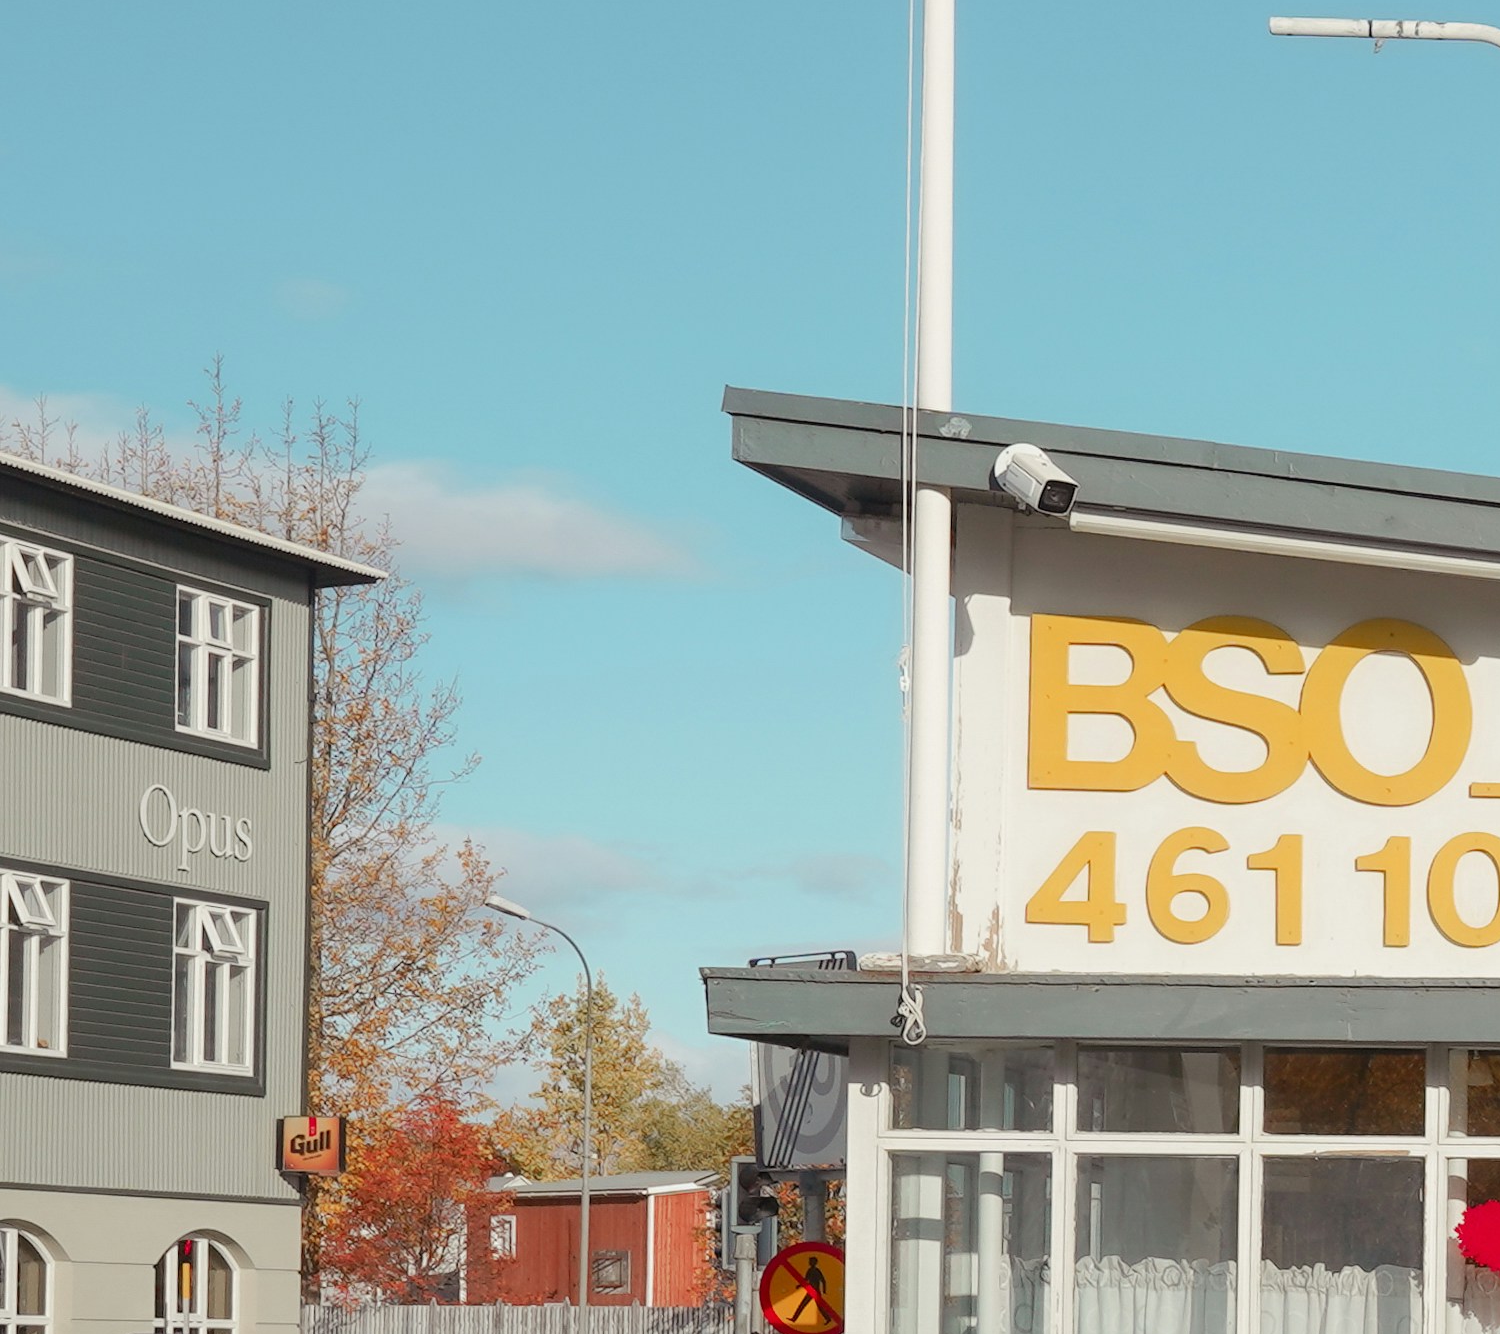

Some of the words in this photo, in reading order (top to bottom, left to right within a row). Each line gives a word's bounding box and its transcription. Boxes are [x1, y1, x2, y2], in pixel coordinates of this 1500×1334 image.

[1026, 613, 1473, 807] BSO
[139, 784, 252, 873] Opus
[1024, 827, 1304, 947] 461
[291, 1130, 331, 1156] Gull
